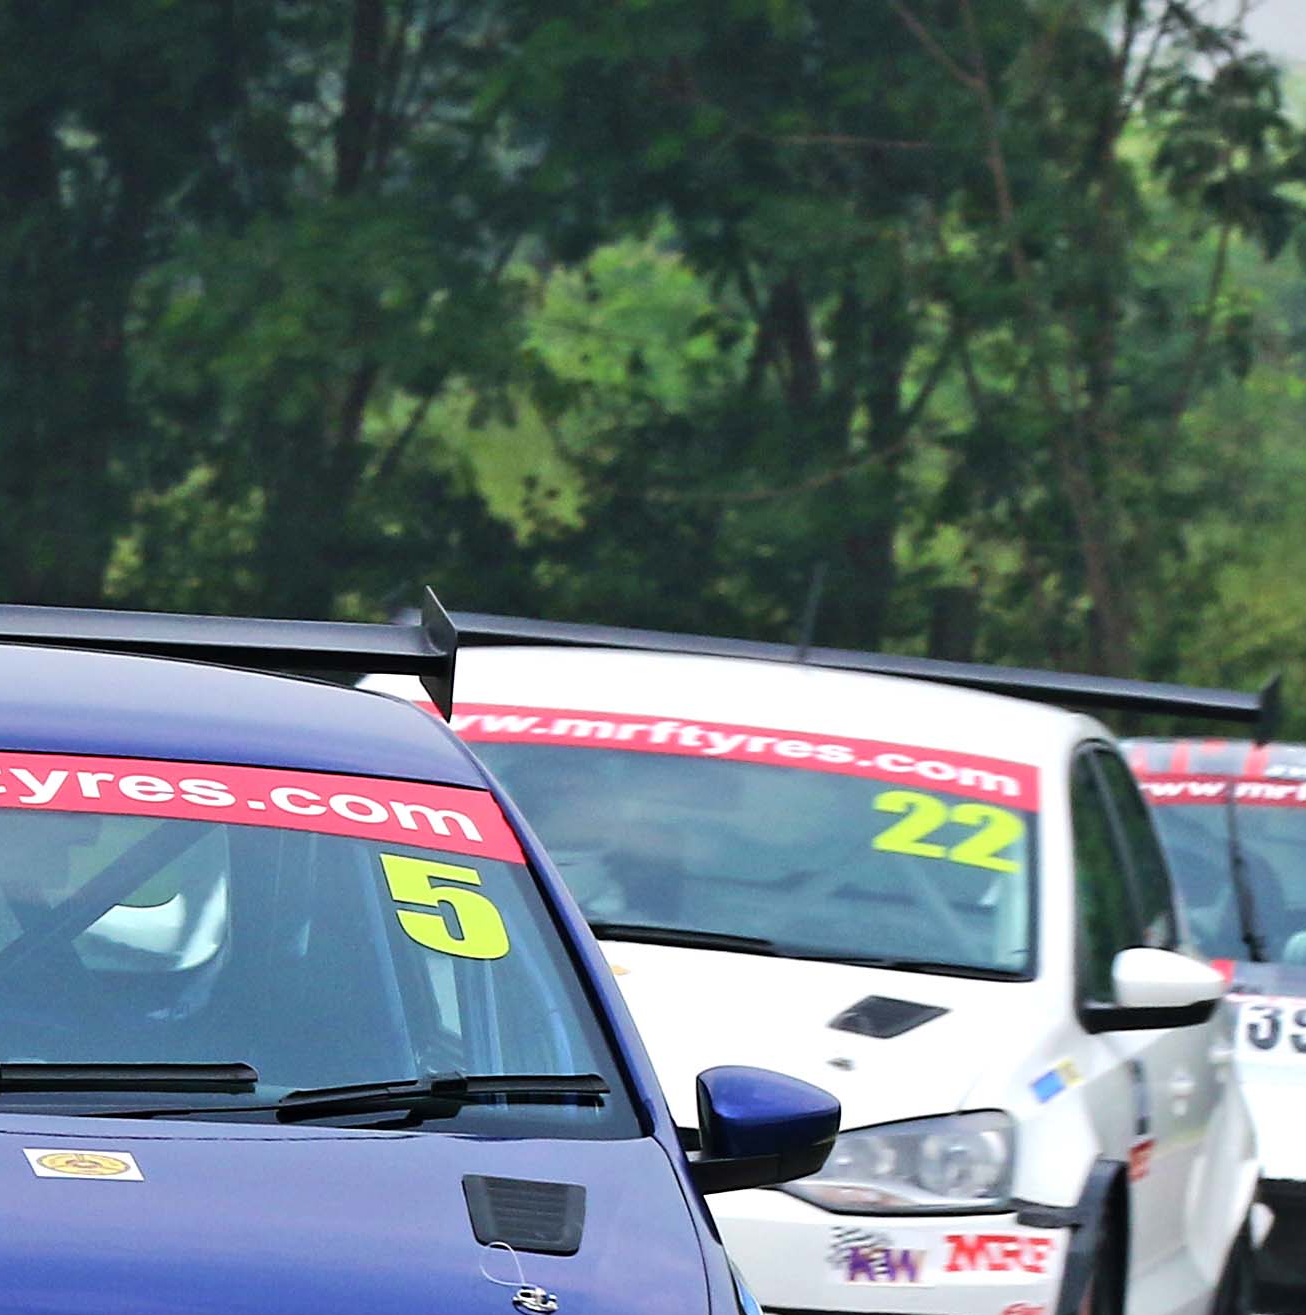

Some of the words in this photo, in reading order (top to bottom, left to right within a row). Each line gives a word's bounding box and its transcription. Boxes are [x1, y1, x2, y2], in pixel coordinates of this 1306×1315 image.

[435, 714, 1022, 798] ww.mrftyres.com
[870, 789, 1027, 874] 22
[379, 853, 511, 961] 5
